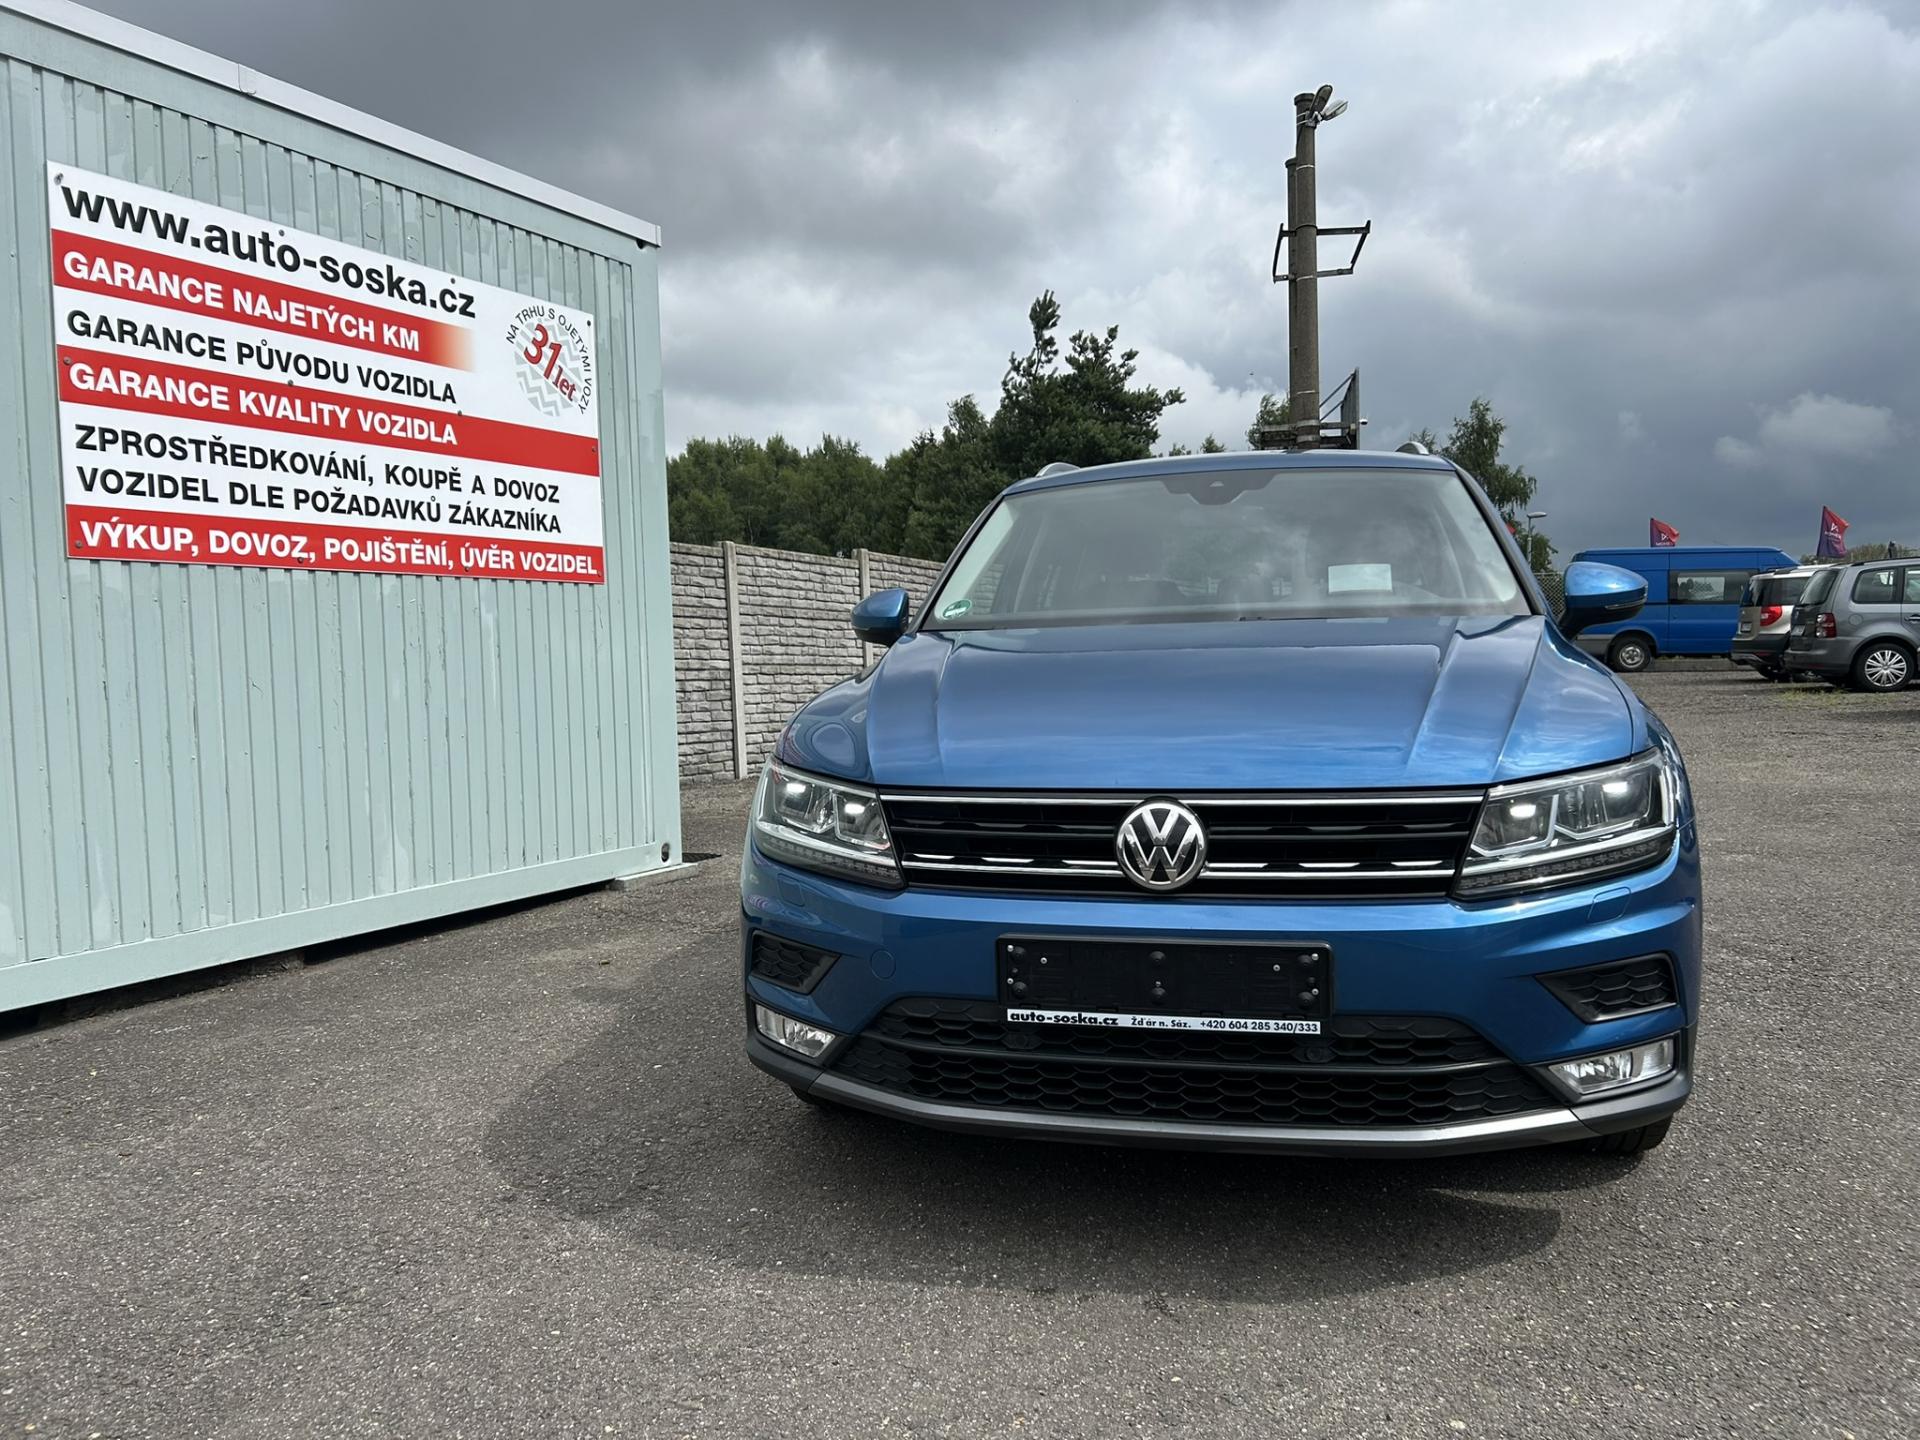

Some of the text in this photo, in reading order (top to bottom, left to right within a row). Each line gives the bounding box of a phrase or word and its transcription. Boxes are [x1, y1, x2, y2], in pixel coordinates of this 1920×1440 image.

[61, 186, 476, 318] www.auto-soska.cz
[63, 251, 419, 351] GARANCE NAJETÝCH KM
[67, 310, 457, 404] GARANCE PŮVODU VOZIDLA
[506, 305, 592, 414] NA TRHU S OJETÝMI VOZY
[523, 323, 576, 402] 31 let
[69, 363, 457, 445] GARANCE KVALITY VOZIDLA
[75, 424, 560, 503] ZPROSTŘEDKOVÁNÍ, KOUPĚ A DOVOZ
[76, 466, 561, 533] VOZIDEL DLE POŽADAVKŮ ZÁKAZNÍKA
[80, 517, 597, 575] VÝKUP, DOVOZ, POJIŠTĚNÍ, ÚVĚR VOZIDEL
[1010, 1011, 1119, 1026] auto-soska.cz
[1158, 1019, 1169, 1028] n.
[1200, 1019, 1226, 1030] +420
[1228, 1020, 1248, 1030] 604
[1250, 1021, 1271, 1031] 285
[1273, 1022, 1318, 1034] 340/333
